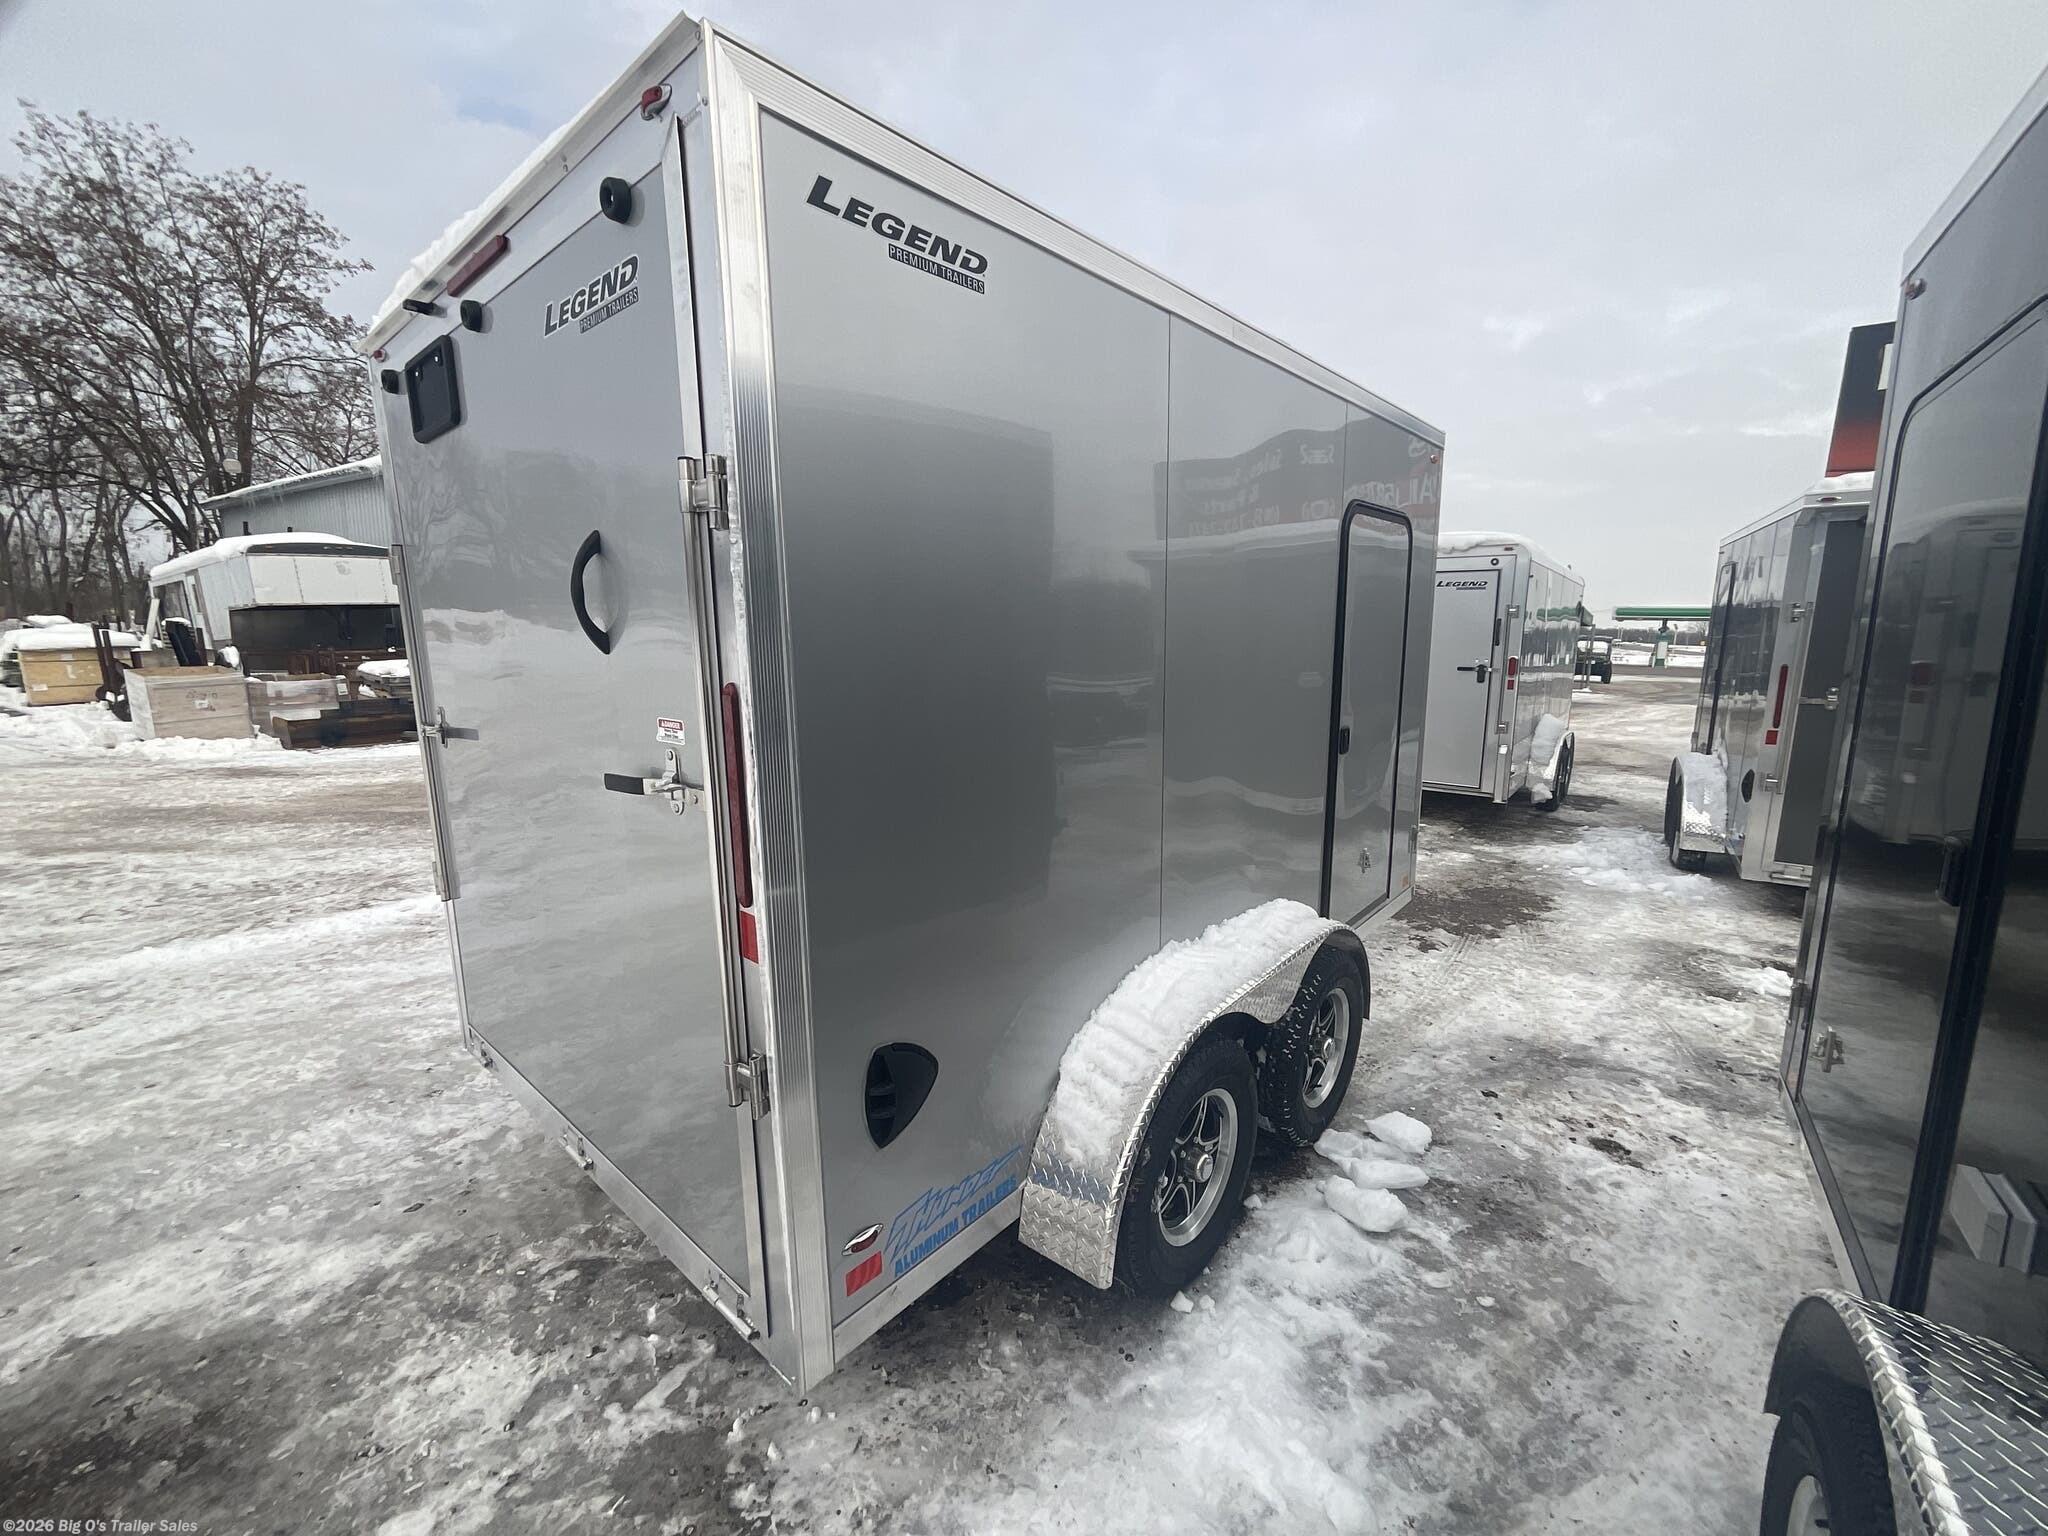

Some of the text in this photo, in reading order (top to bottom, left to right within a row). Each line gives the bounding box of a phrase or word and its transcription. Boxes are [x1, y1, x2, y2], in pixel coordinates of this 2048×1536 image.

[806, 174, 988, 275] LEGEND
[544, 255, 639, 336] LEGEND
[888, 245, 985, 294] PREMIUM TRAILERS
[580, 288, 639, 333] PREMIUM TRAILERS
[1436, 580, 1488, 588] LEGEND
[895, 1174, 1018, 1278] ALUMINUM TRAILERS
